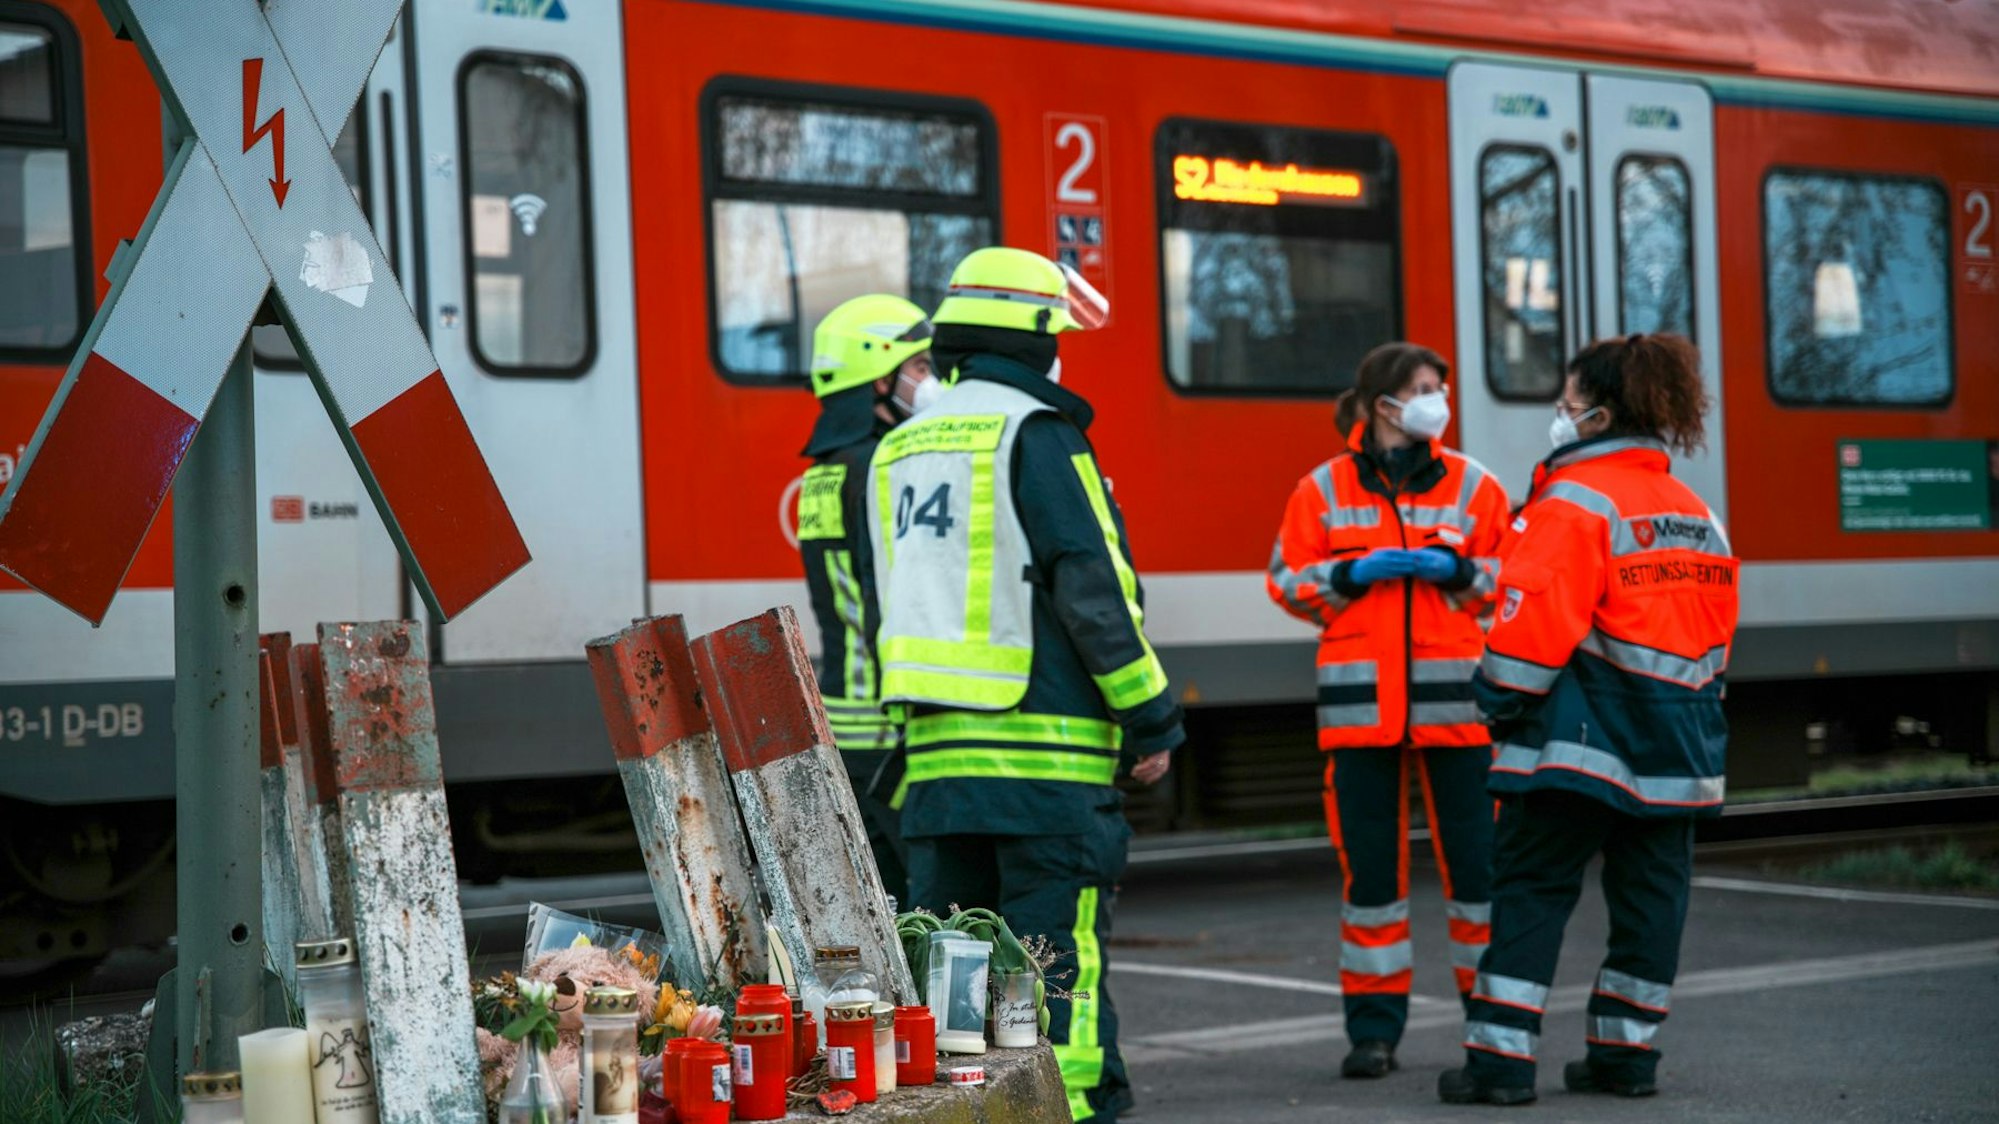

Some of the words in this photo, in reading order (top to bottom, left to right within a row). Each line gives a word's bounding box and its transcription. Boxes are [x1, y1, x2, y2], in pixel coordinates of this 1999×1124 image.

[1055, 122, 1096, 203] 2
[1965, 190, 1991, 257] 2
[308, 502, 359, 519] BAHN
[0, 705, 52, 741] 3-1
